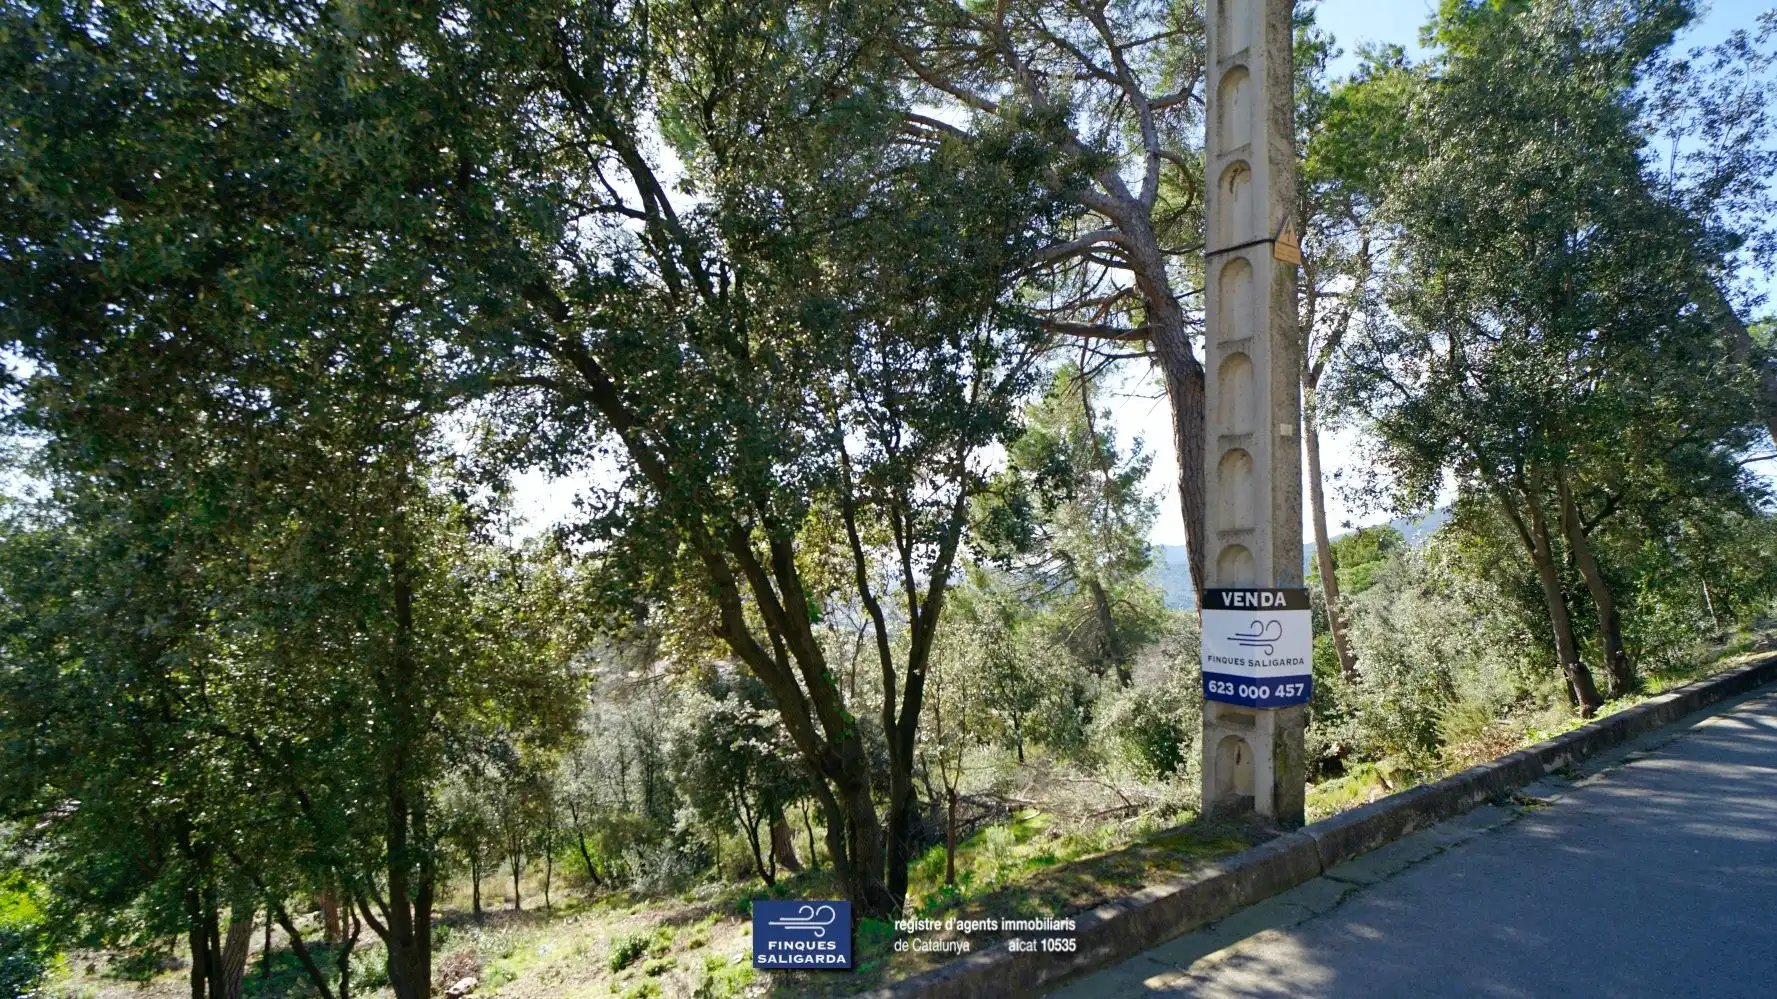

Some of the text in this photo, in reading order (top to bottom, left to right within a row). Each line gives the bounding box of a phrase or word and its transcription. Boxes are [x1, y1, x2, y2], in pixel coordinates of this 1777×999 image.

[1222, 591, 1287, 607] VENDA
[1207, 655, 1305, 668] FINQUES SALIGARDA
[1208, 680, 1305, 699] 623 000 457
